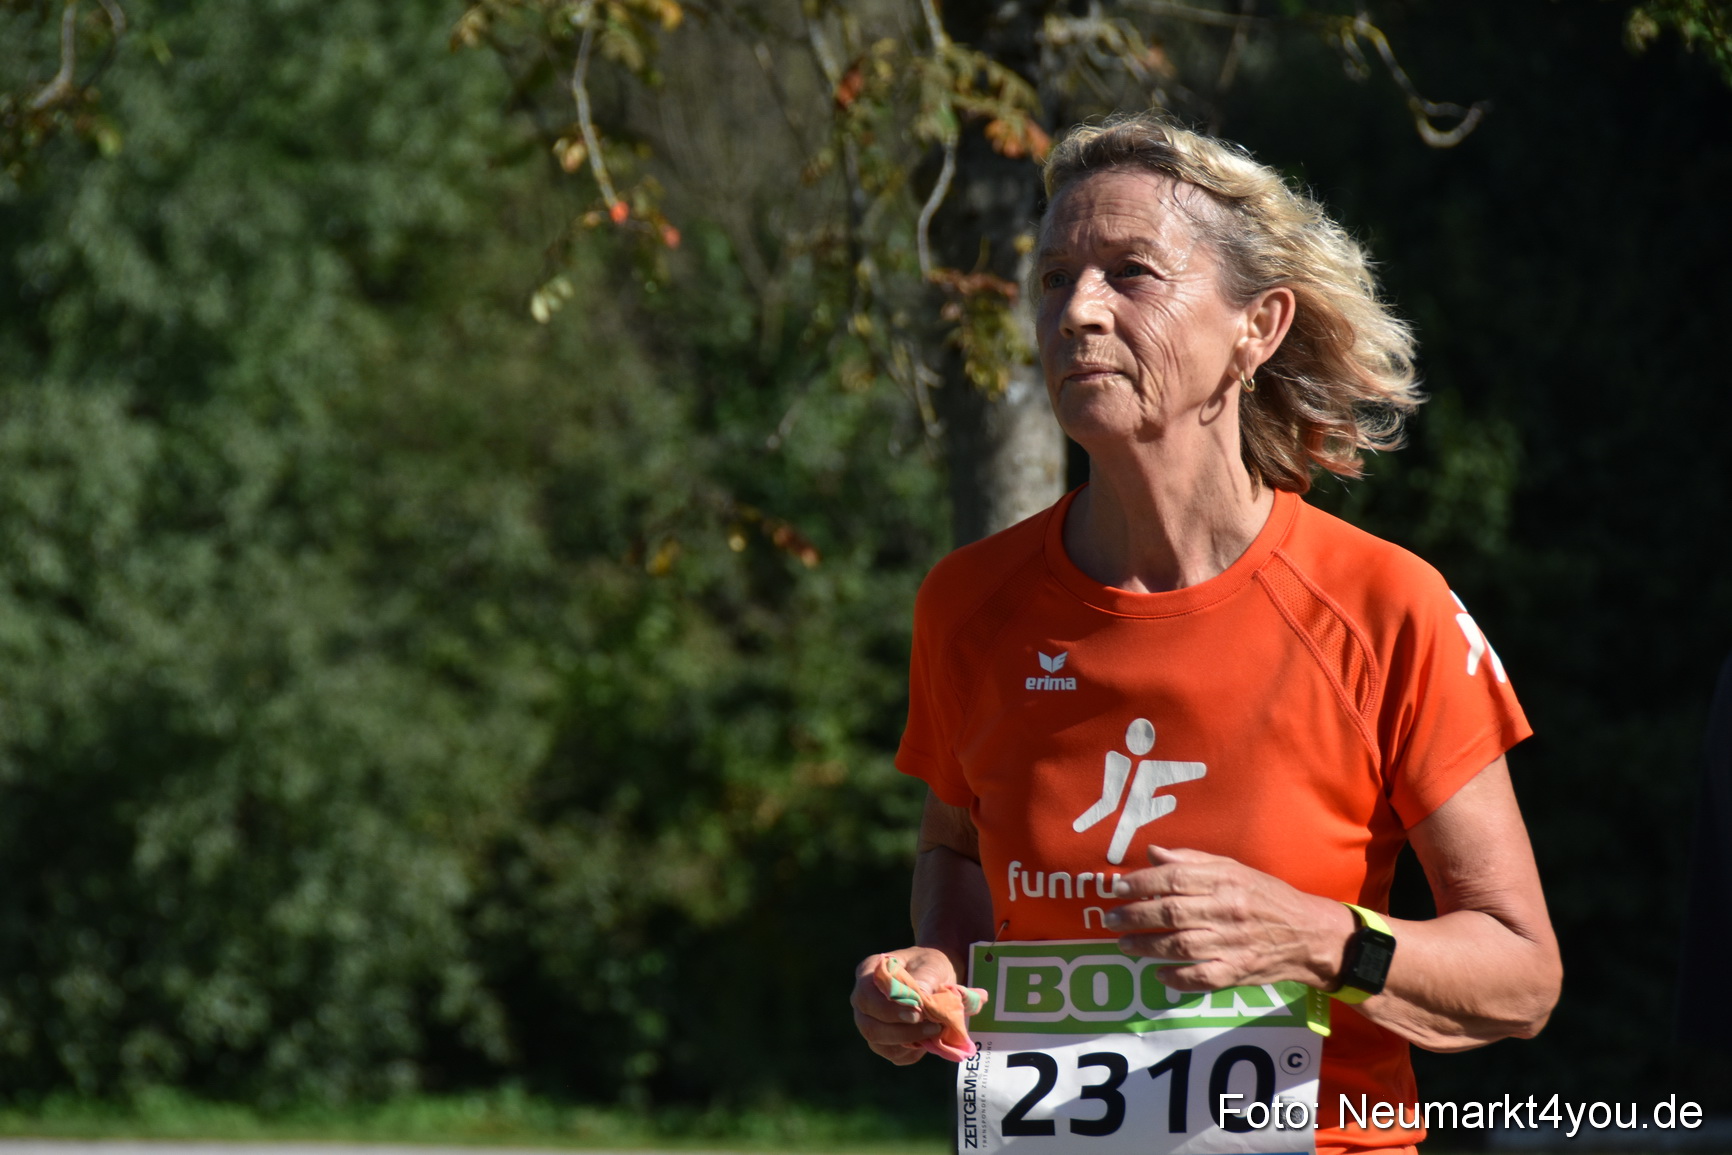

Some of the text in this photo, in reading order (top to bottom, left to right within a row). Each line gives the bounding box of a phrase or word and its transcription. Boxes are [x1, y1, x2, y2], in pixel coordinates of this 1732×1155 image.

[1025, 675, 1077, 690] erima
[982, 1041, 993, 1089] ZEITMESSUNG
[1001, 1044, 1276, 1137] 2310
